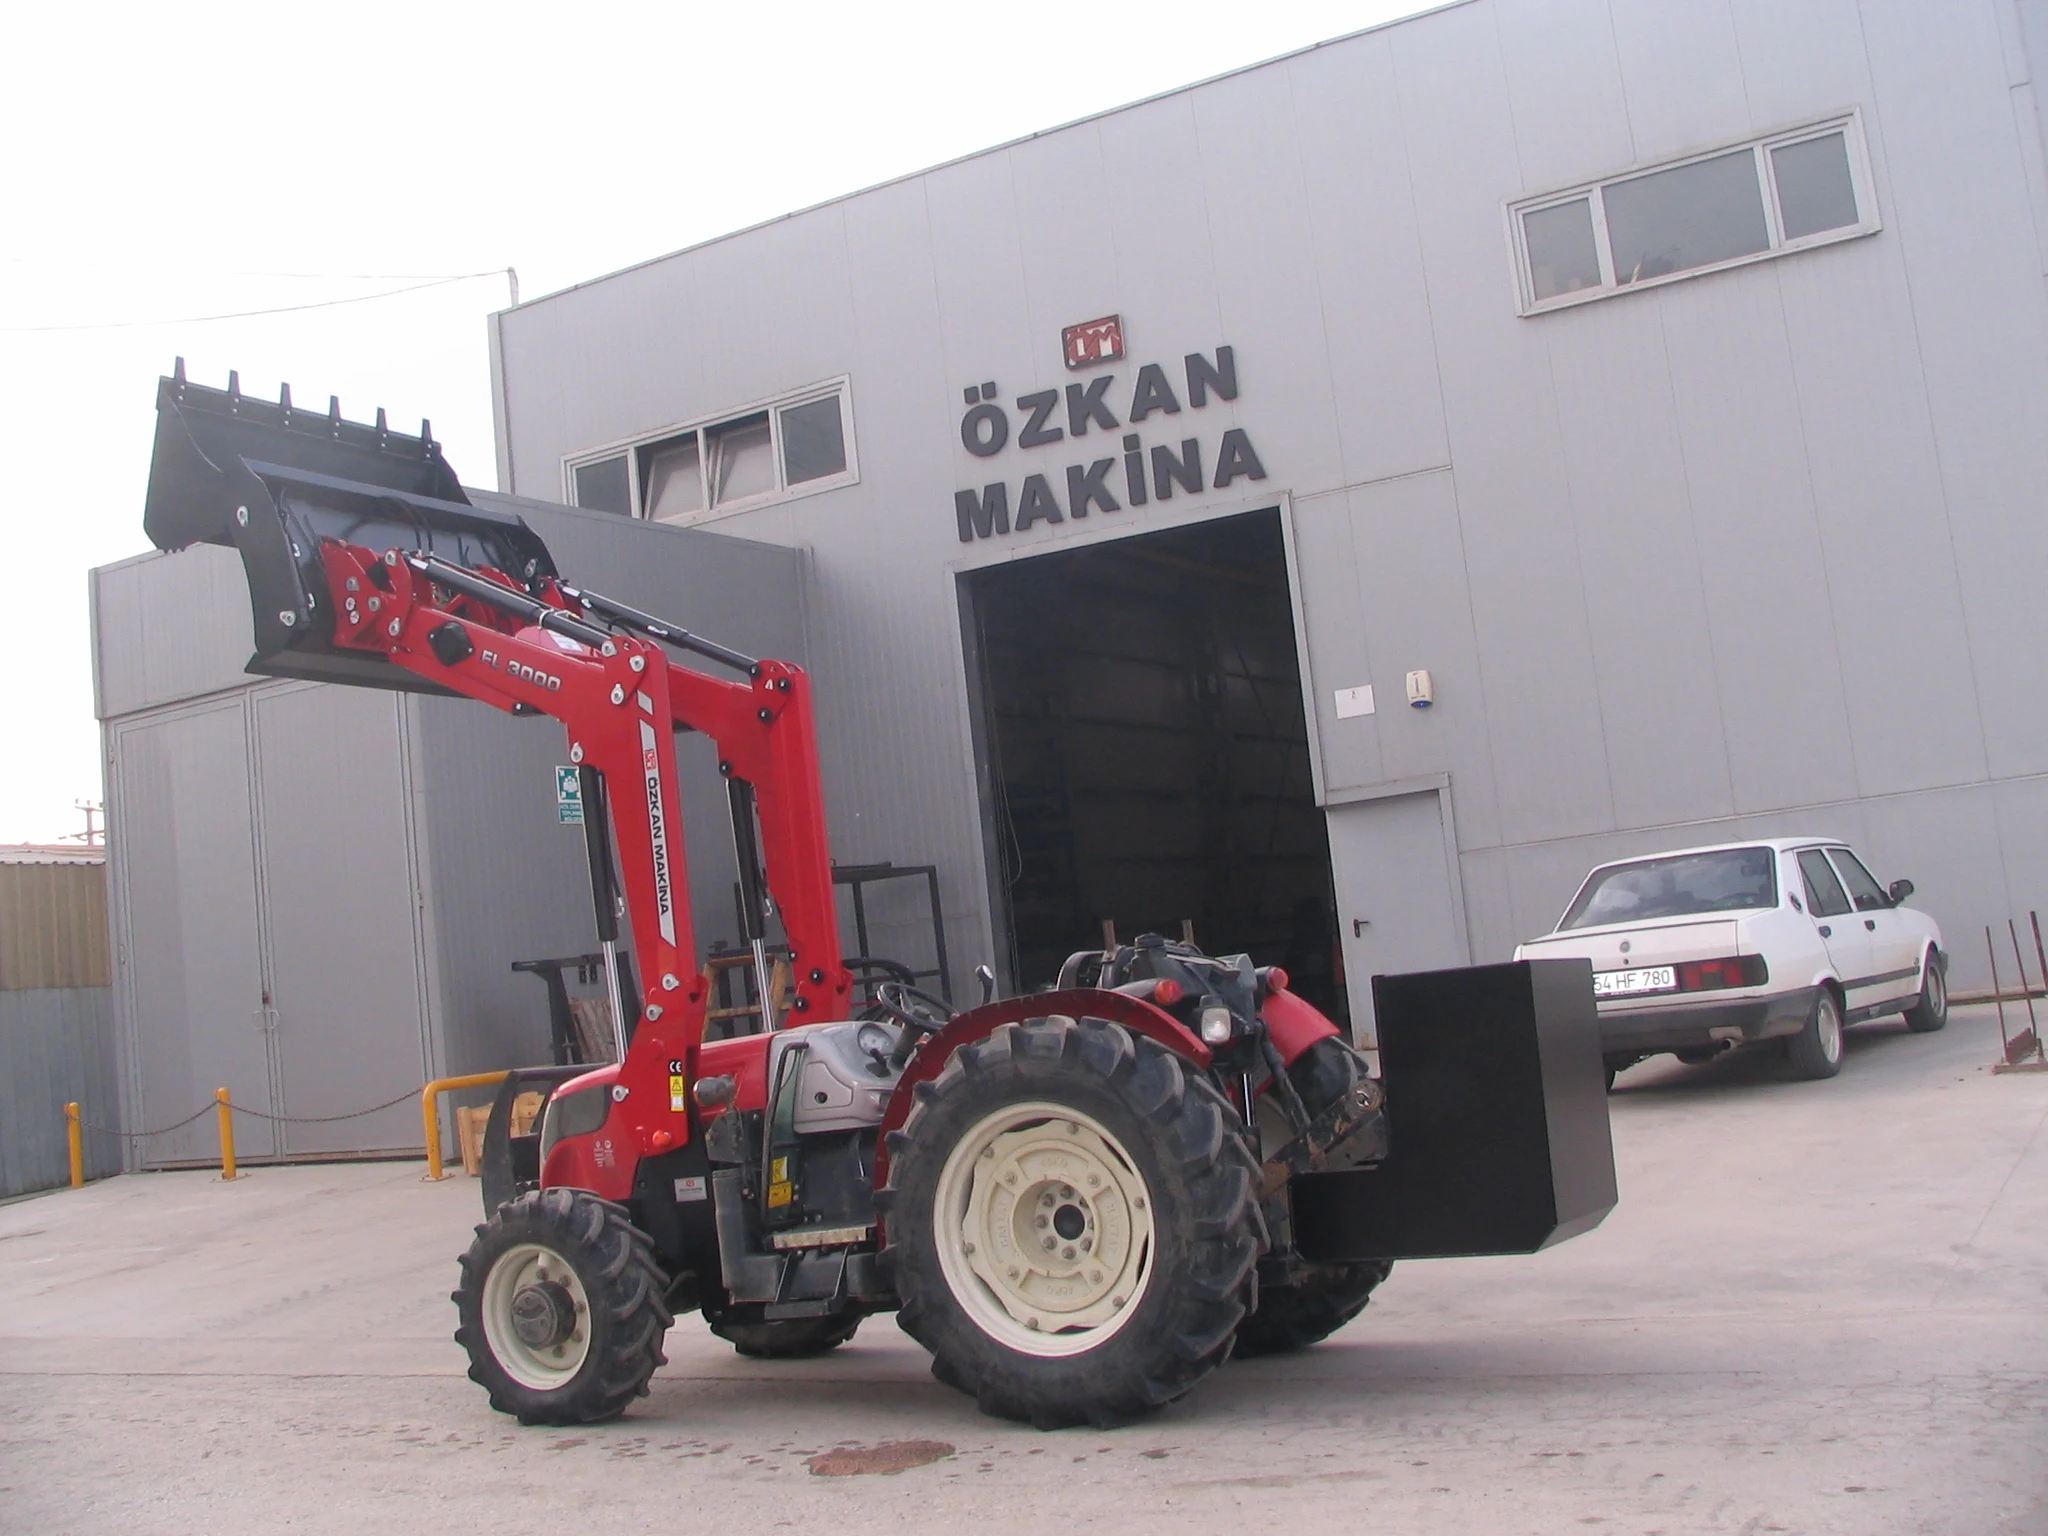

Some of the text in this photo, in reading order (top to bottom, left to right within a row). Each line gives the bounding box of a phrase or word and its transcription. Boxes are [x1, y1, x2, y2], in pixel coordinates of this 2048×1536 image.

[960, 345, 1239, 457] ÖZKAN
[954, 428, 1267, 543] MAKİNA
[481, 649, 562, 691] FL 3000
[647, 776, 670, 916] ÖZKAN MAKİNA
[1615, 973, 1637, 989] HF
[1643, 969, 1670, 986] 780
[669, 1060, 682, 1073] CE
